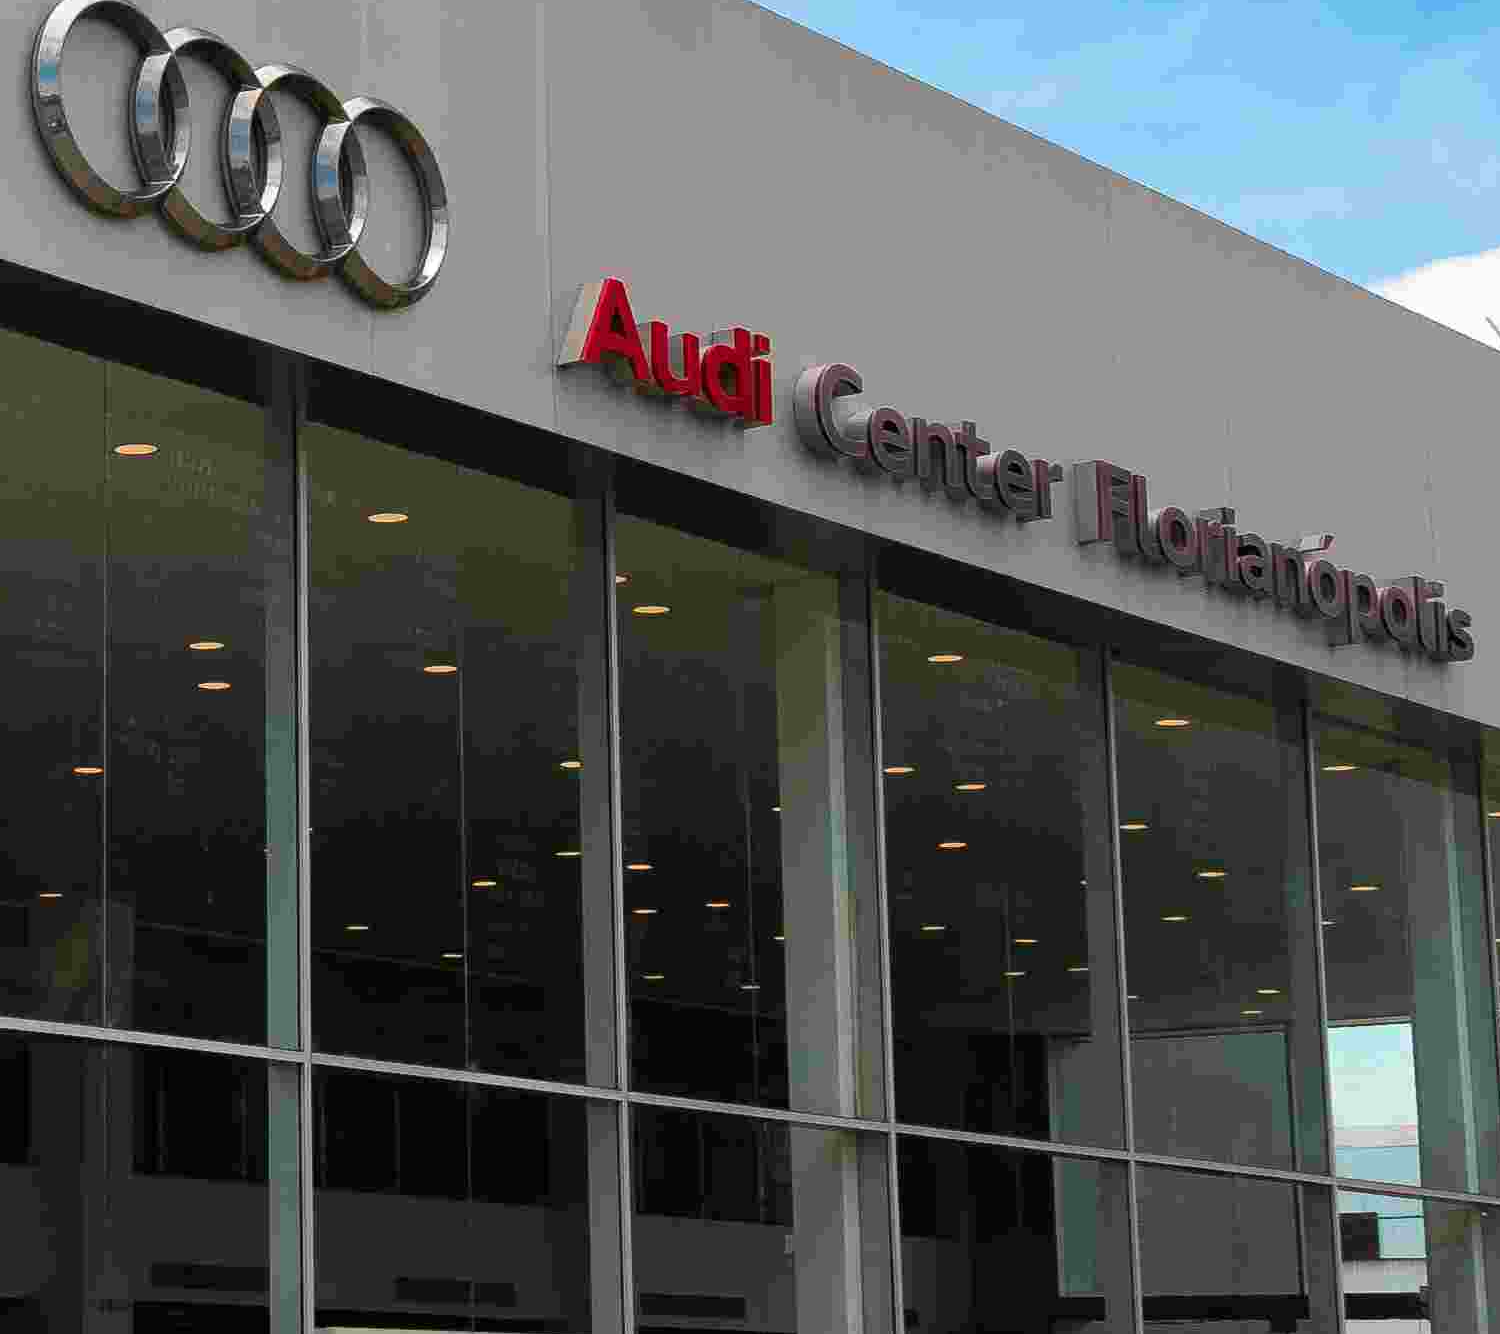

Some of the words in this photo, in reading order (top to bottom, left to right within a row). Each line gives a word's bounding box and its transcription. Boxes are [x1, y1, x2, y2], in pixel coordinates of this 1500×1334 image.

[566, 276, 775, 429] Audi
[793, 363, 1064, 524] Center
[1074, 460, 1474, 665] Florianópolis
